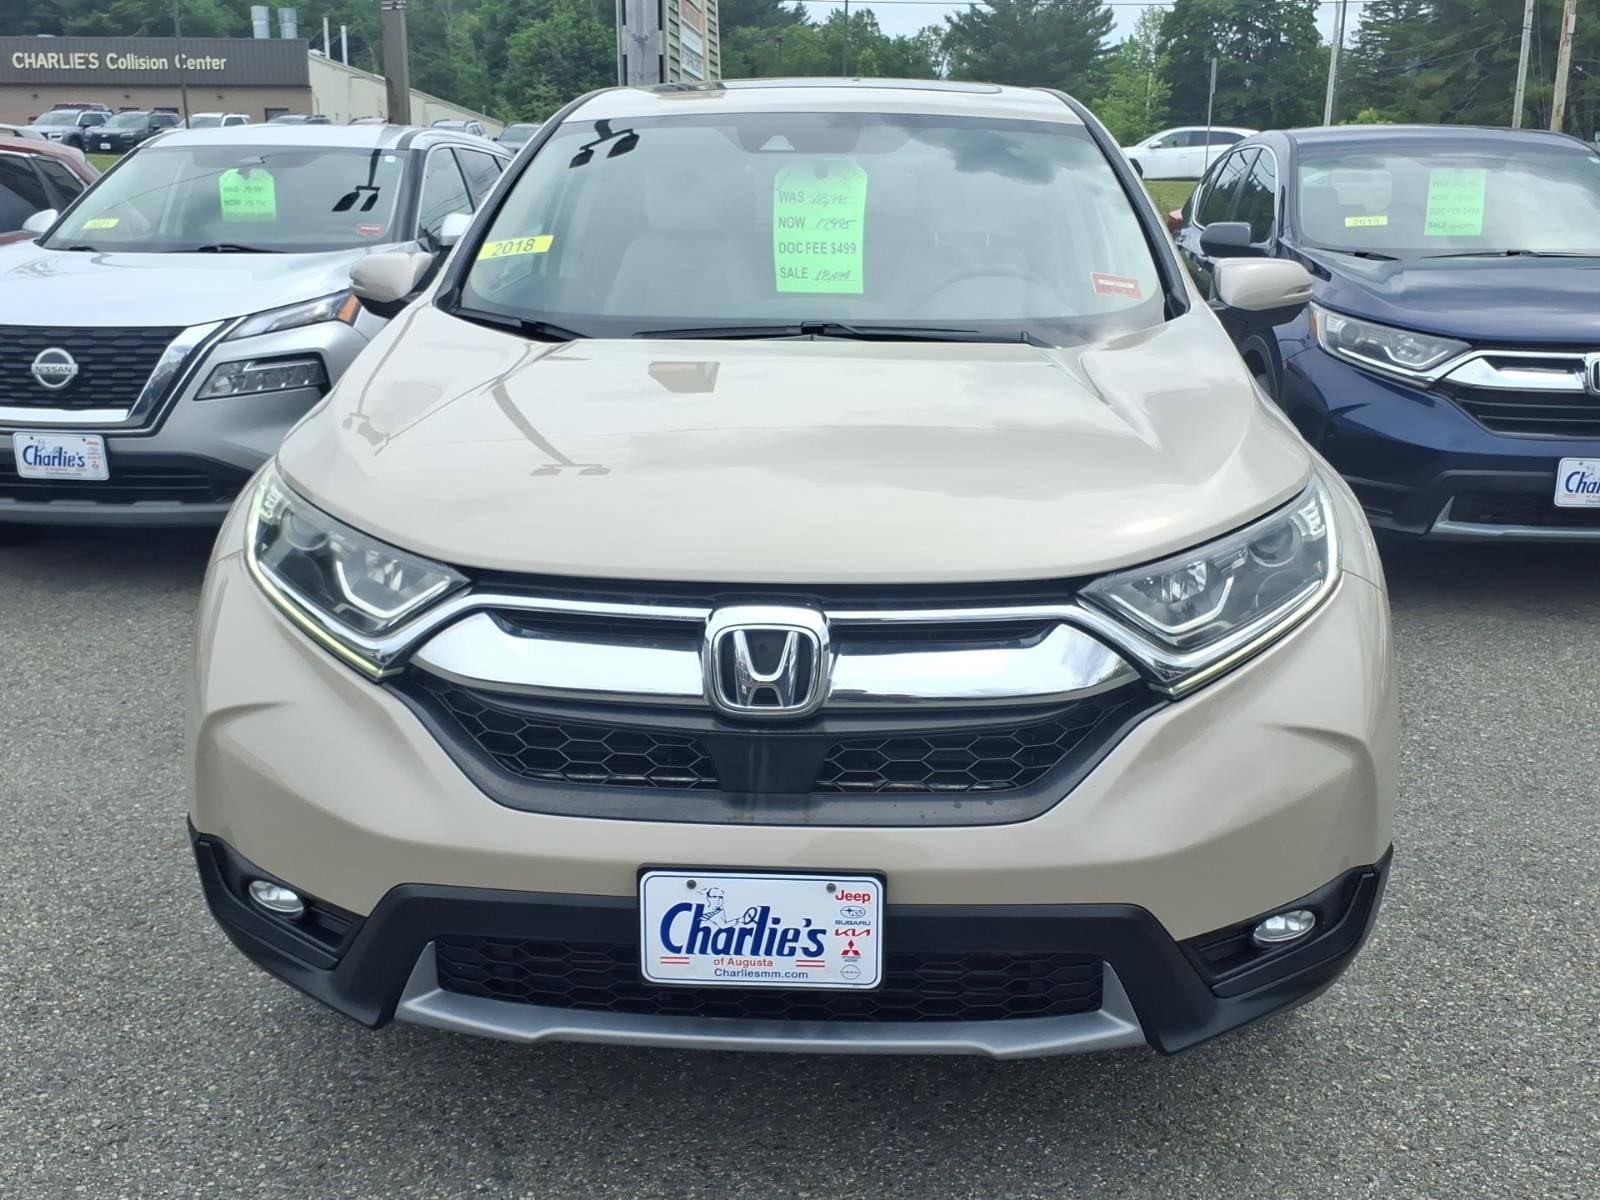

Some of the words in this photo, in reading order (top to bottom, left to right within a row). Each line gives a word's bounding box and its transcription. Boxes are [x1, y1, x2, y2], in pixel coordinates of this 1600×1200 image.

[12, 52, 99, 69] CHARLIE'S
[106, 52, 168, 70] Collision
[175, 54, 227, 70] Center
[778, 191, 804, 203] WAS
[778, 216, 806, 229] NOW
[492, 239, 536, 256] 2018
[779, 242, 803, 254] DOC
[806, 242, 827, 254] FEE
[831, 242, 857, 255] $499
[779, 266, 809, 280] SALE
[35, 365, 73, 373] NISSAN
[22, 445, 86, 468] Charlie's
[835, 889, 871, 904] Jeep
[660, 902, 827, 958] Charlie's
[713, 957, 725, 966] of
[727, 957, 774, 969] Augusta
[714, 967, 809, 979] Charliesmm.com
